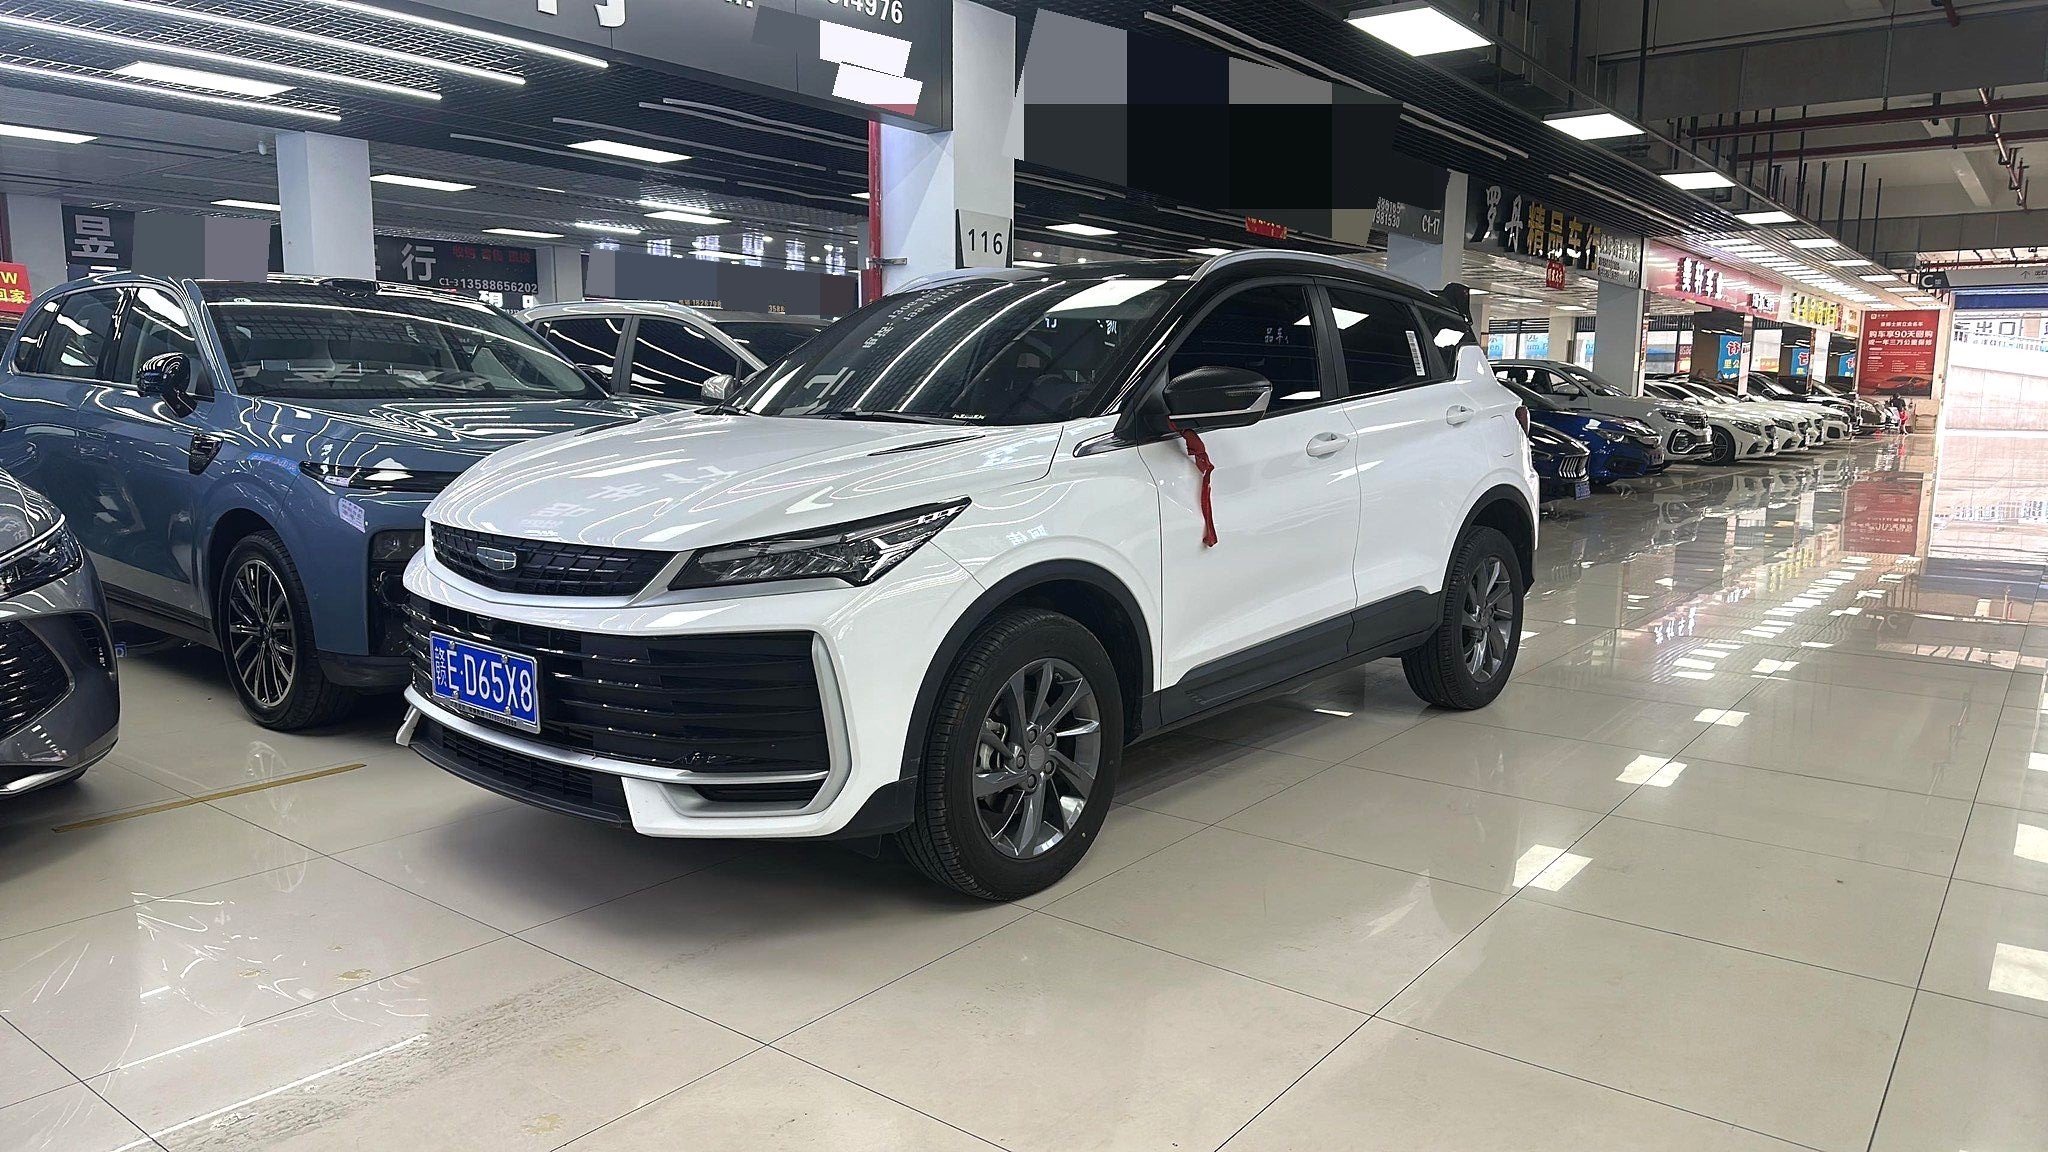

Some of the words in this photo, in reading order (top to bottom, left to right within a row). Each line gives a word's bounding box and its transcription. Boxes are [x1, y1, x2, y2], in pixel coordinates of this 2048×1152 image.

[1422, 214, 1440, 235] C1-17
[72, 214, 119, 260] 昱
[968, 228, 1003, 255] 116
[460, 278, 538, 293] 13588656202
